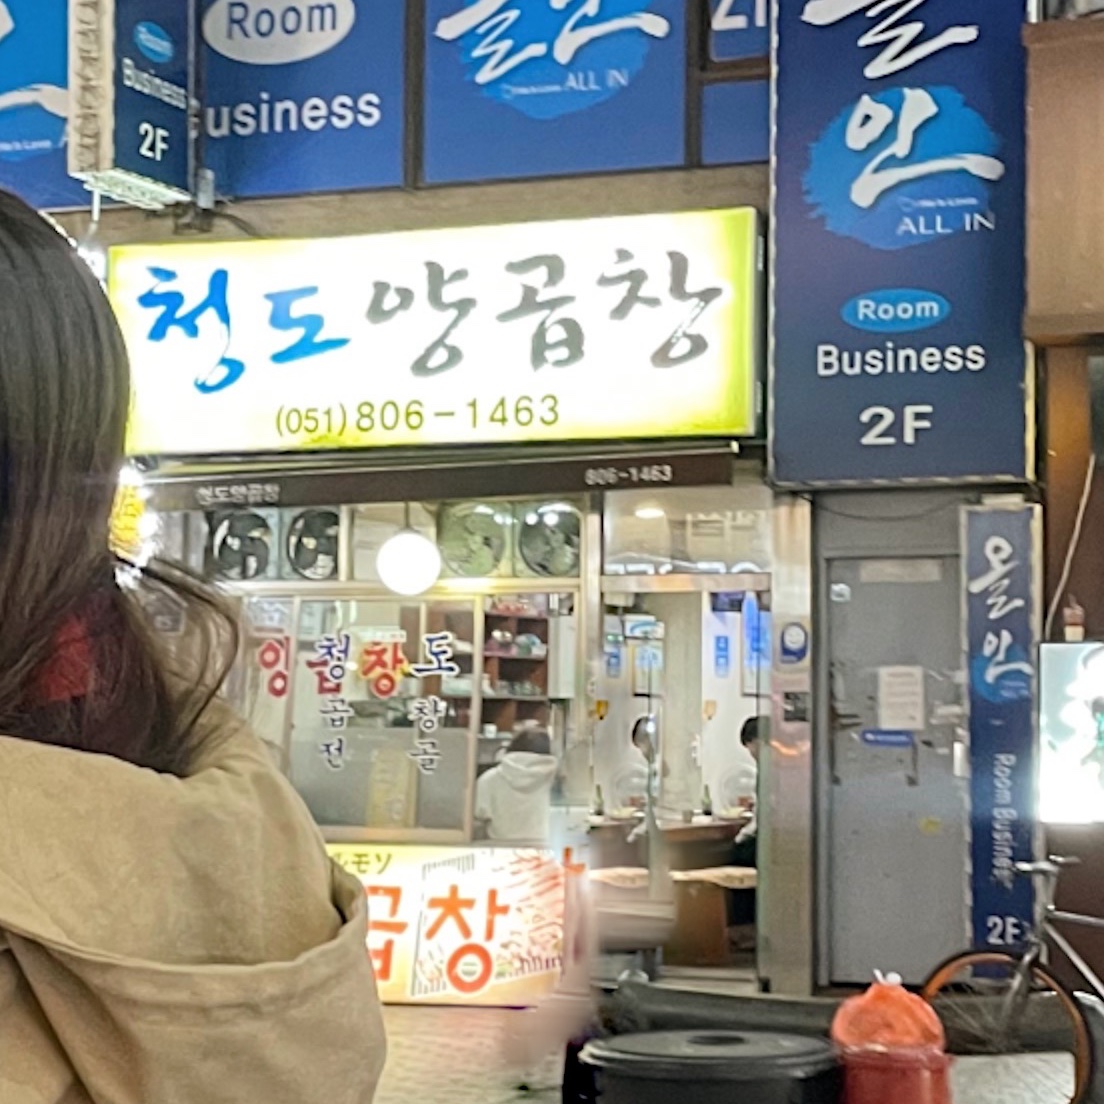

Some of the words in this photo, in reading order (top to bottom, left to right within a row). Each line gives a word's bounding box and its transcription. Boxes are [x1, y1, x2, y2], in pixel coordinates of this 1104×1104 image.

[227, 1, 337, 40] Room
[563, 72, 598, 91] ALL
[607, 69, 629, 87] IN
[138, 122, 170, 161] 2F
[897, 215, 953, 235] ALL
[963, 212, 995, 231] IN
[857, 299, 939, 321] Room
[816, 342, 986, 377] Business
[859, 405, 933, 445] 2F
[584, 464, 673, 486] 806-1463
[992, 753, 1017, 804] Room
[986, 915, 1021, 945] 2F
